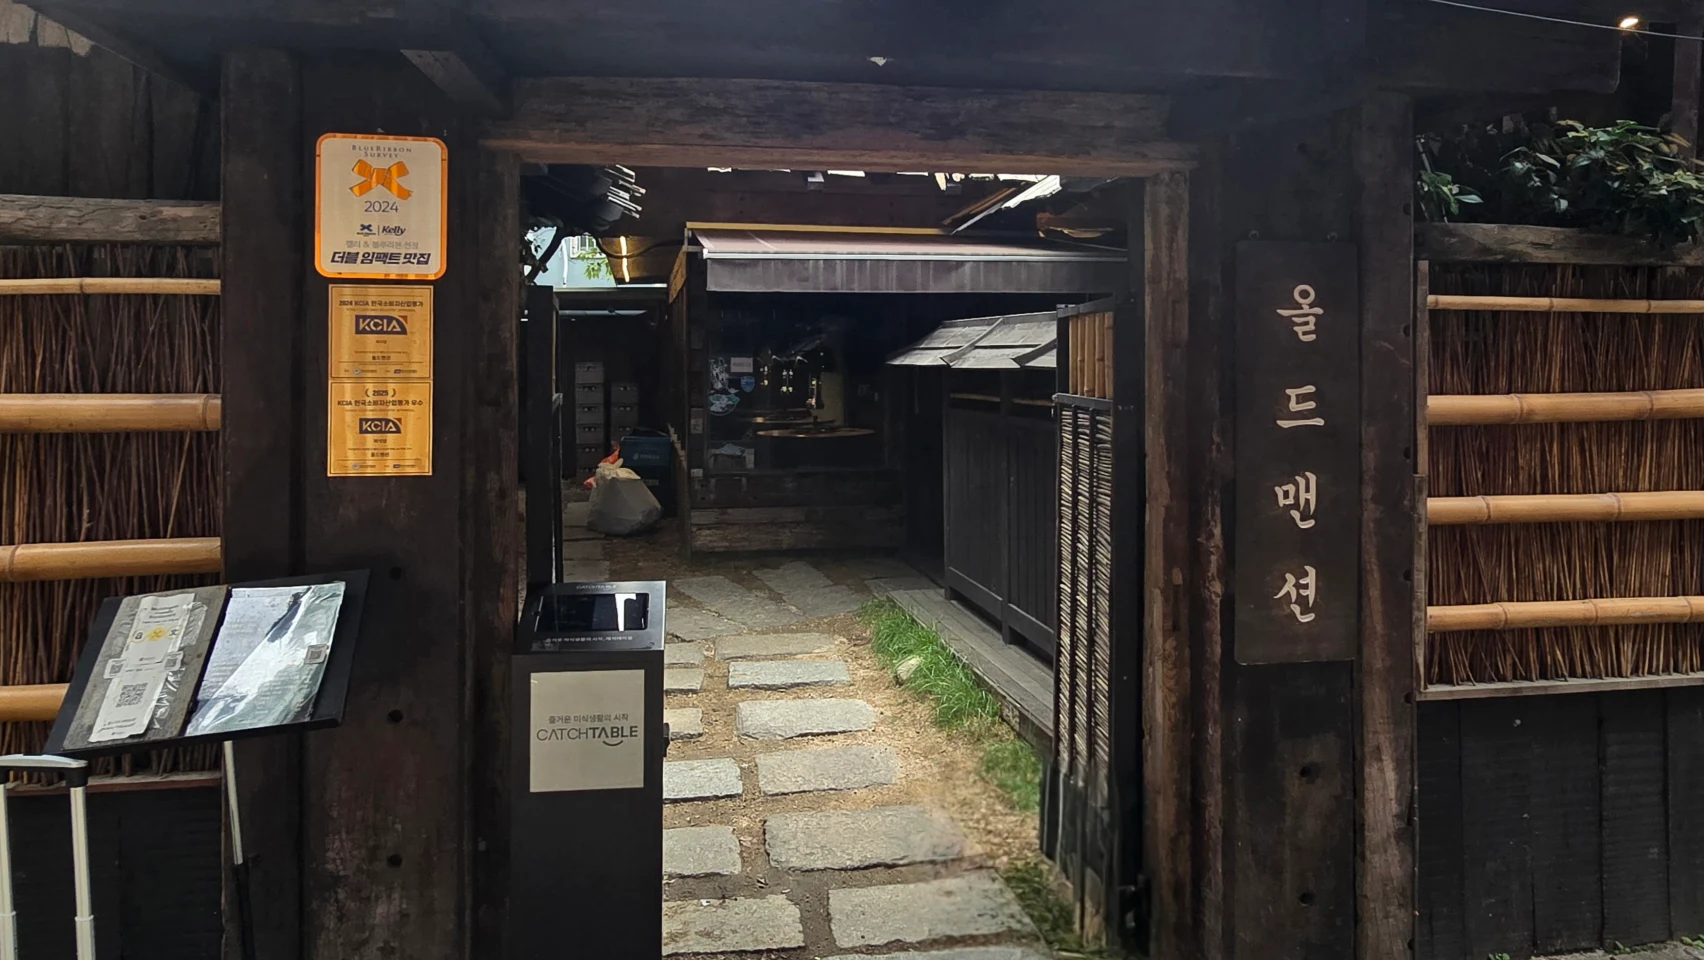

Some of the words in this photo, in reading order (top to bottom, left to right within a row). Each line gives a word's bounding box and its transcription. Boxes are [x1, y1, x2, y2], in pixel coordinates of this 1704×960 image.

[364, 200, 399, 213] 2024
[381, 225, 407, 237] Kelly
[330, 251, 359, 264] 더블
[360, 251, 402, 265] 임팩트
[401, 252, 432, 265] 맛집
[359, 318, 402, 332] KCIA
[362, 420, 397, 432] KCIA
[1274, 284, 1325, 623] 올드맨션
[548, 715, 572, 725] 즐거운
[573, 713, 612, 723] 미식생활의
[613, 713, 629, 722] 시작
[536, 725, 639, 742] CATCHTABLE
